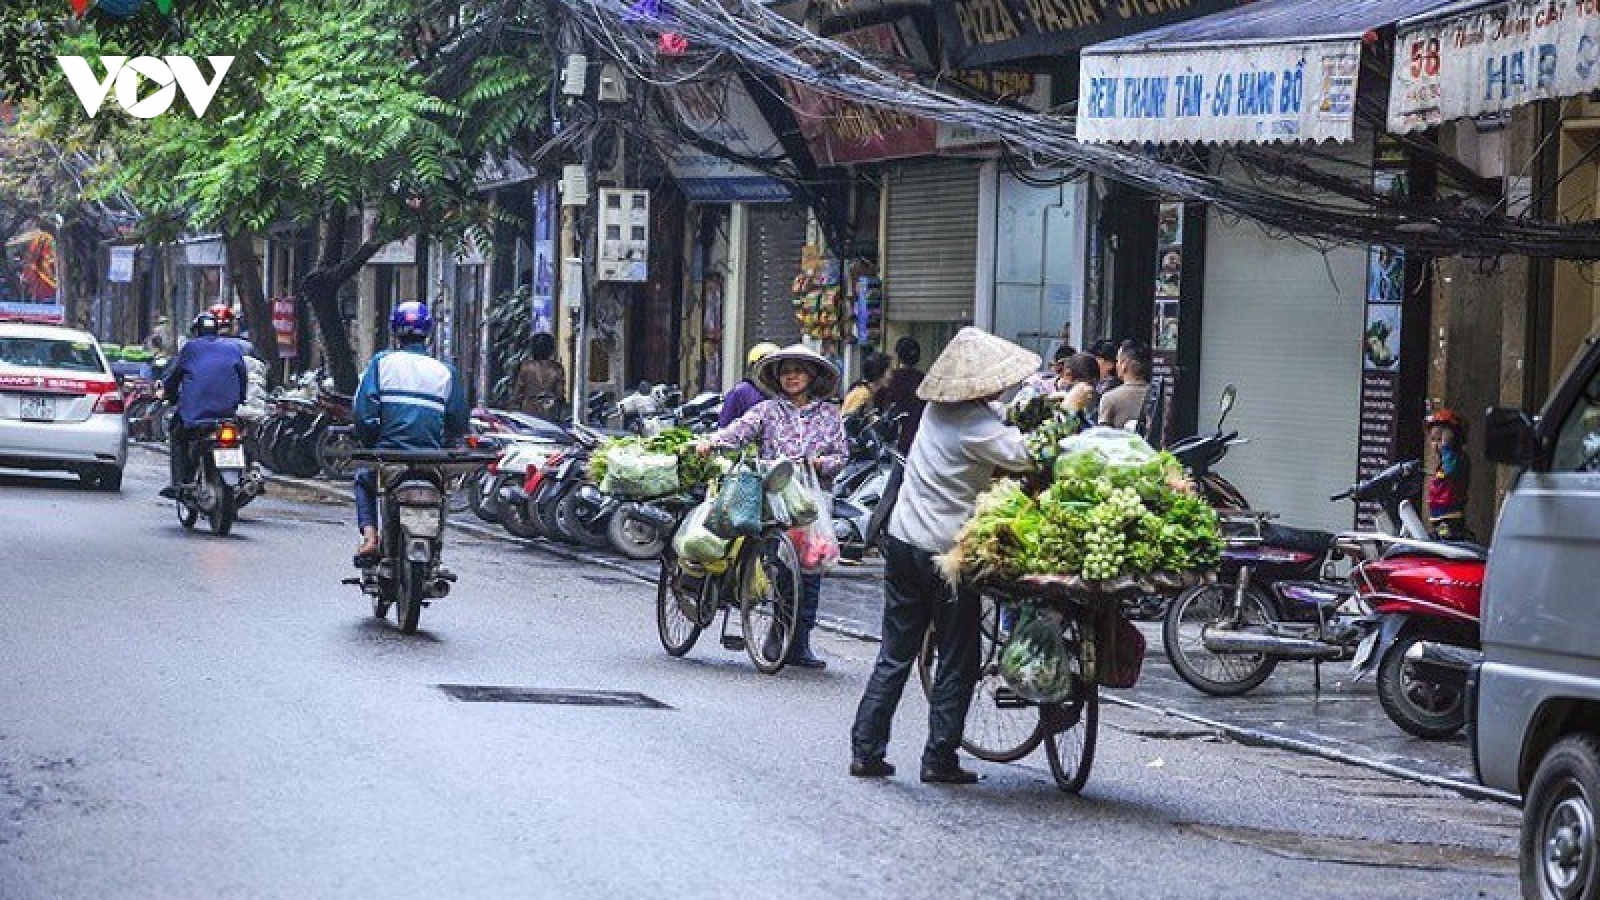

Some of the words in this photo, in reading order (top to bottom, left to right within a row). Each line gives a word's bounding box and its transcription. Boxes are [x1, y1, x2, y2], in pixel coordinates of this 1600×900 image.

[954, 0, 1021, 46] PIZZA
[1410, 37, 1441, 79] 58
[1123, 77, 1168, 118] THANH
[1211, 73, 1233, 117] 60
